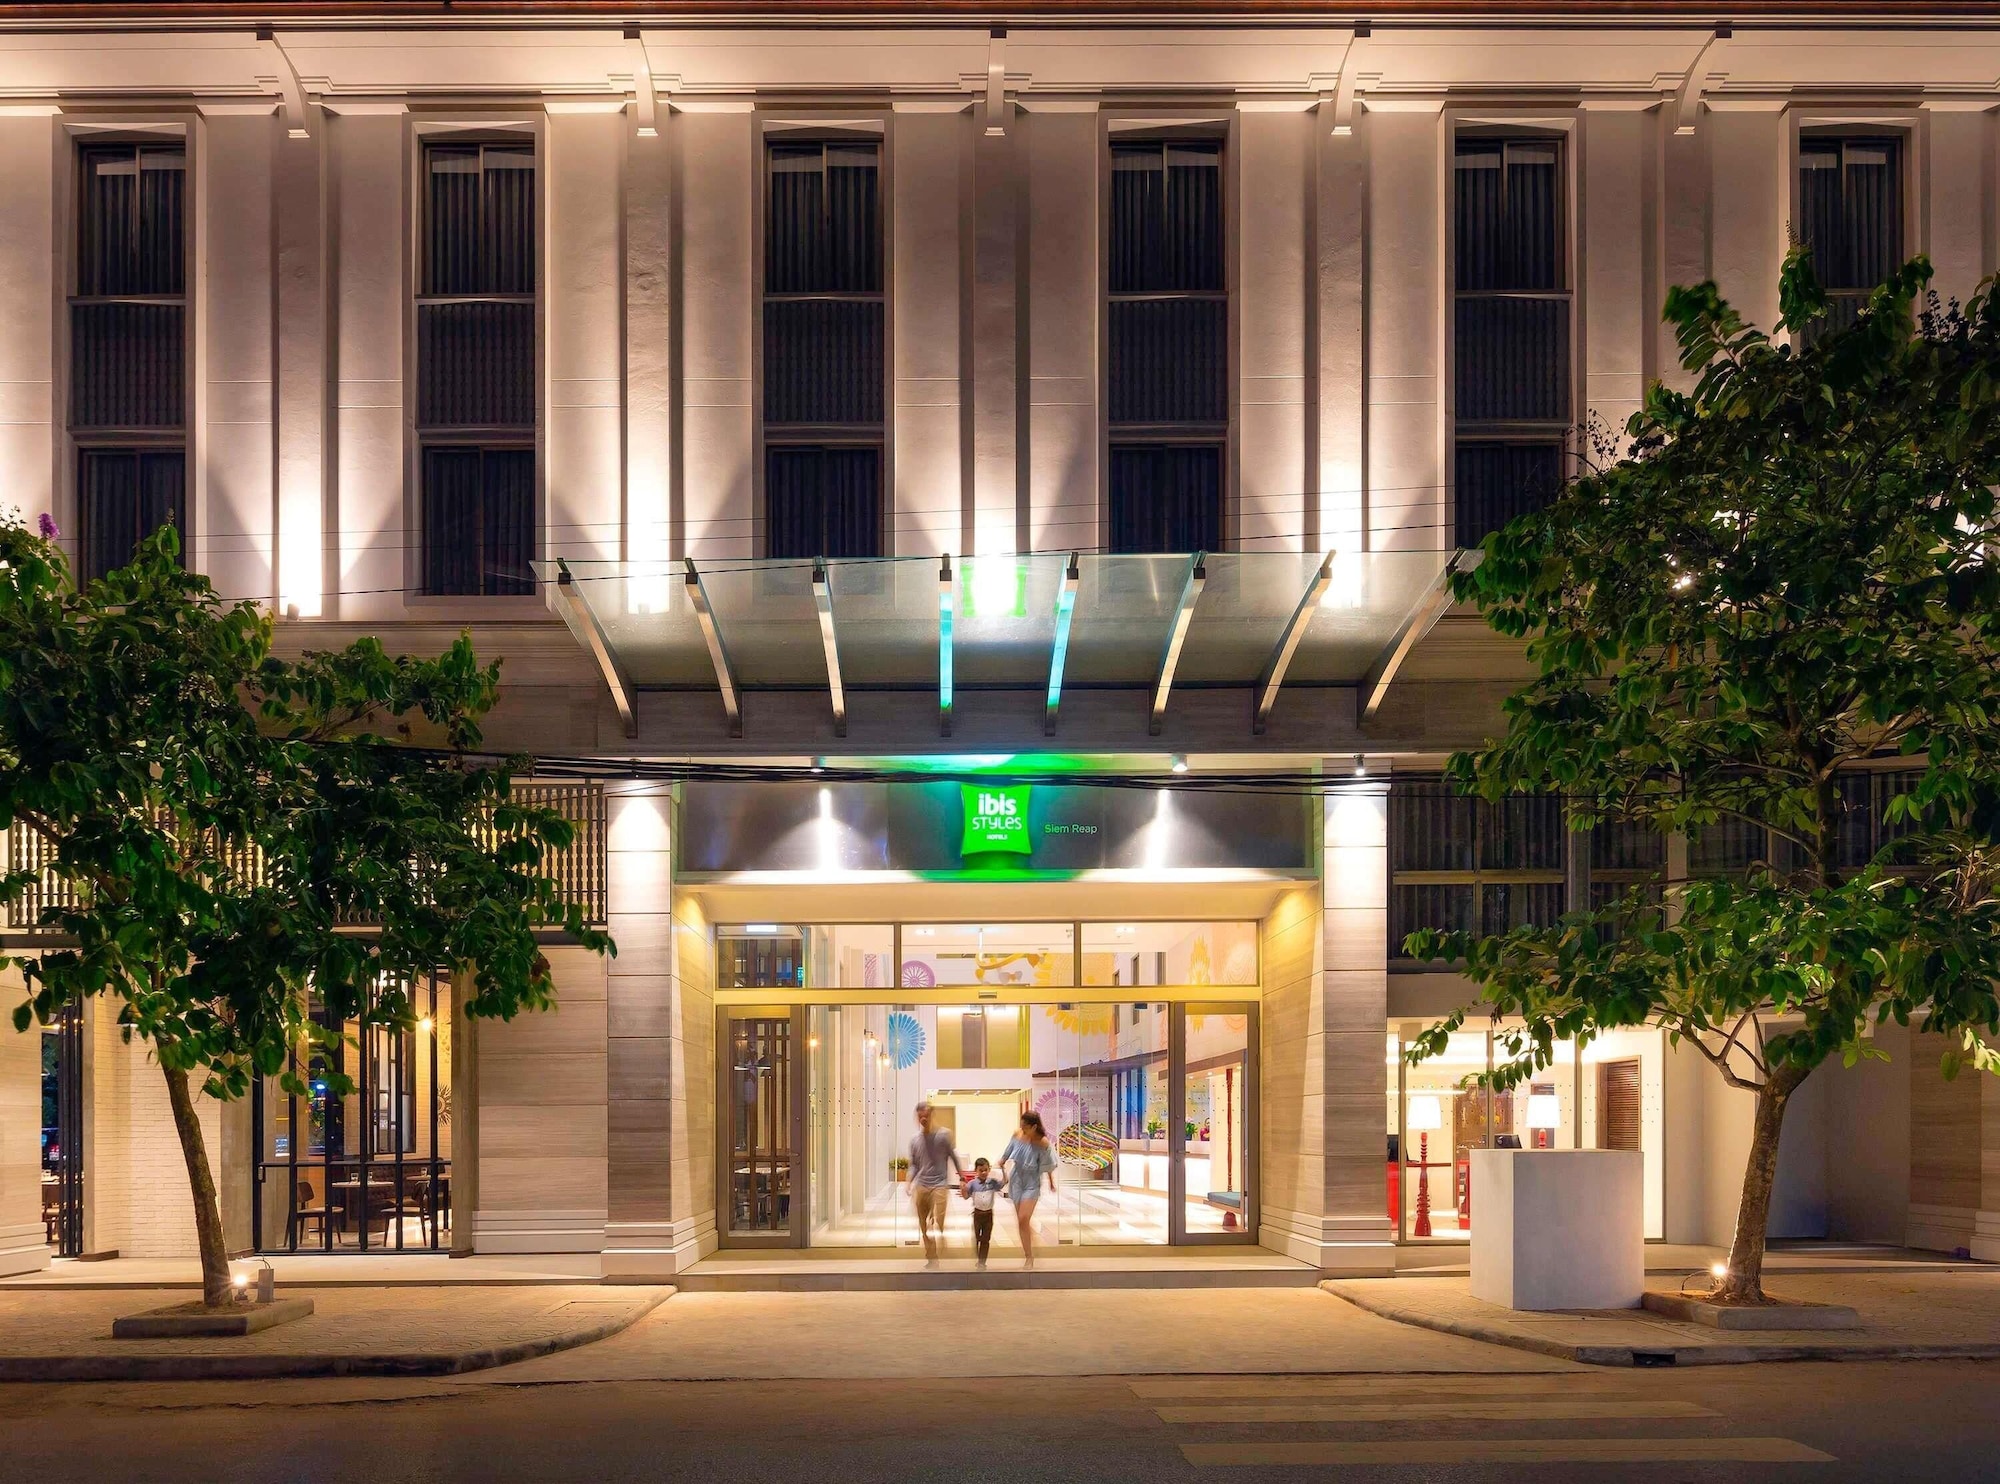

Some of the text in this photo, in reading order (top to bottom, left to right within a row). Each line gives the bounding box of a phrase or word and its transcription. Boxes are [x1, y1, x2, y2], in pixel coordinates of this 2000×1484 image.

[979, 793, 1016, 815] ibis
[1045, 824, 1097, 835] Siem Reap
